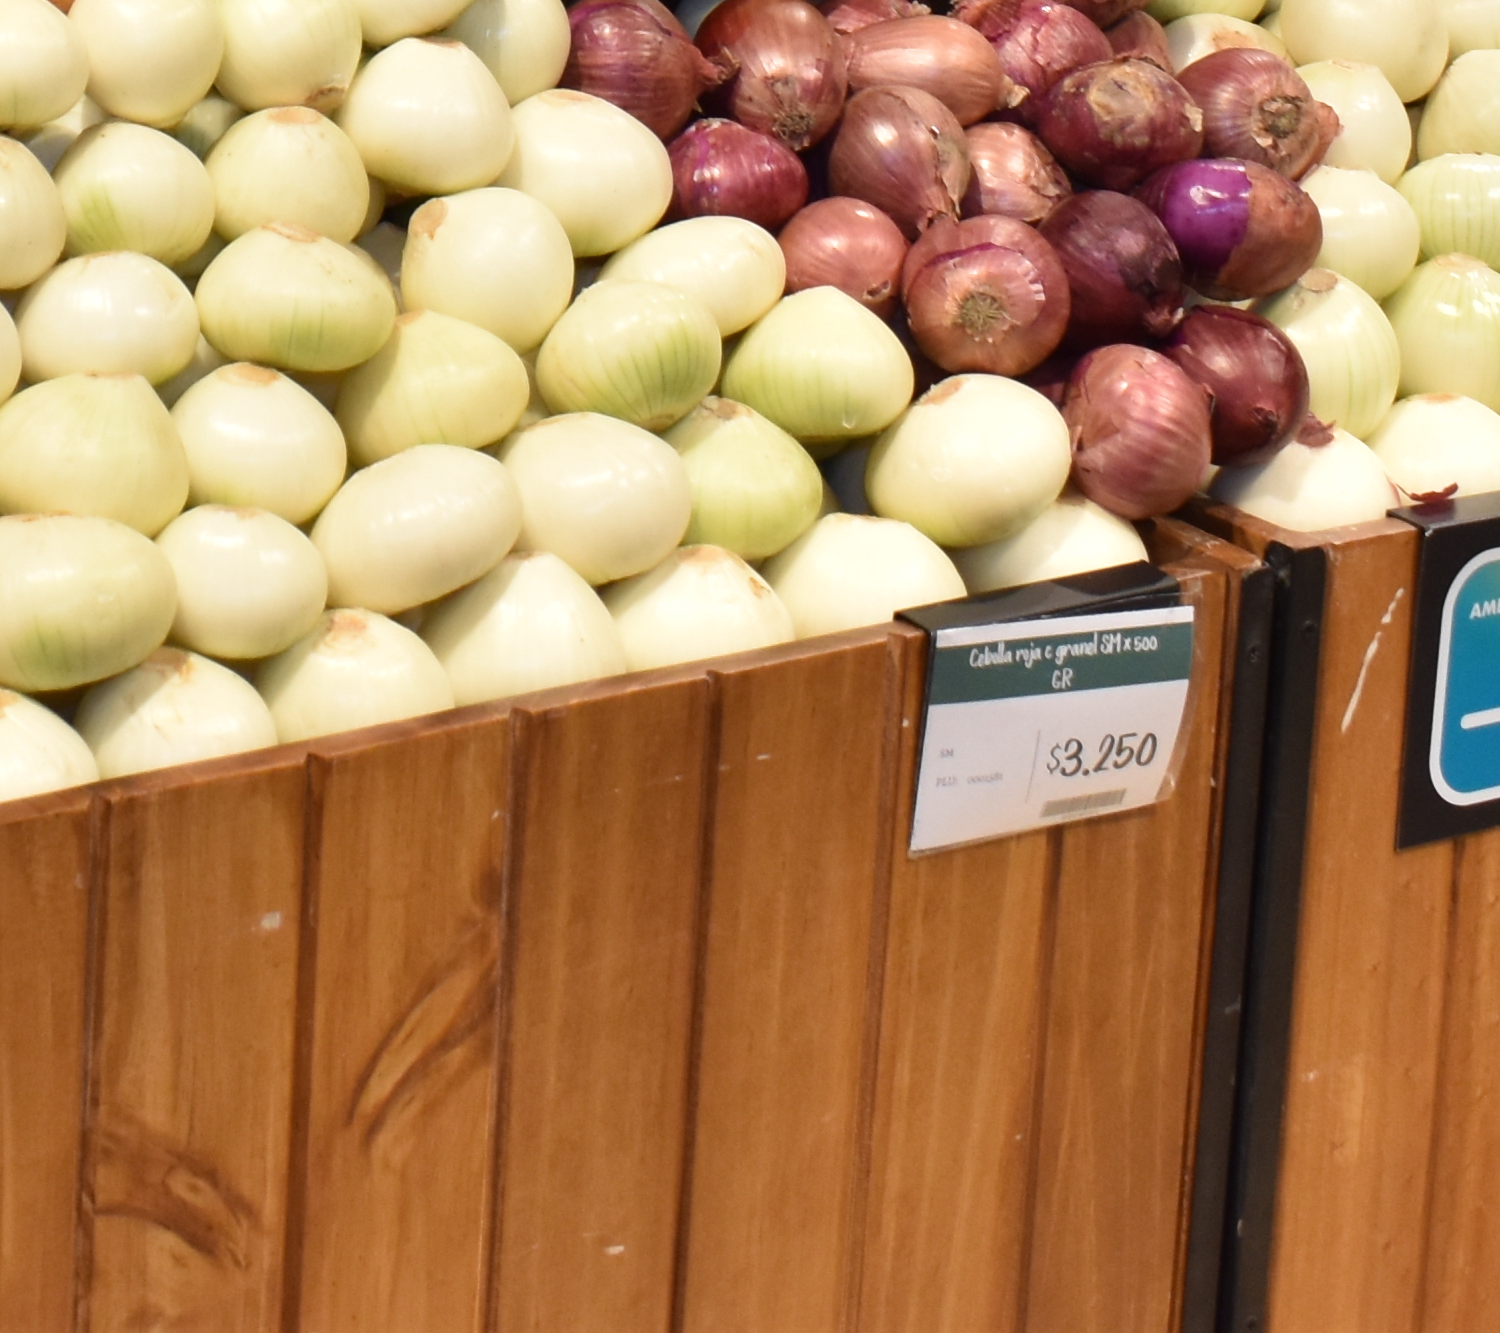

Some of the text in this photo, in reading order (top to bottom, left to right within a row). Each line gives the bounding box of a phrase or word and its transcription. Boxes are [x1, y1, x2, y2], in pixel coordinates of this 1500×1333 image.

[1015, 640, 1042, 669] roja
[1100, 632, 1123, 655] SM
[1133, 634, 1158, 652] 500
[1045, 731, 1158, 778] $3.250
